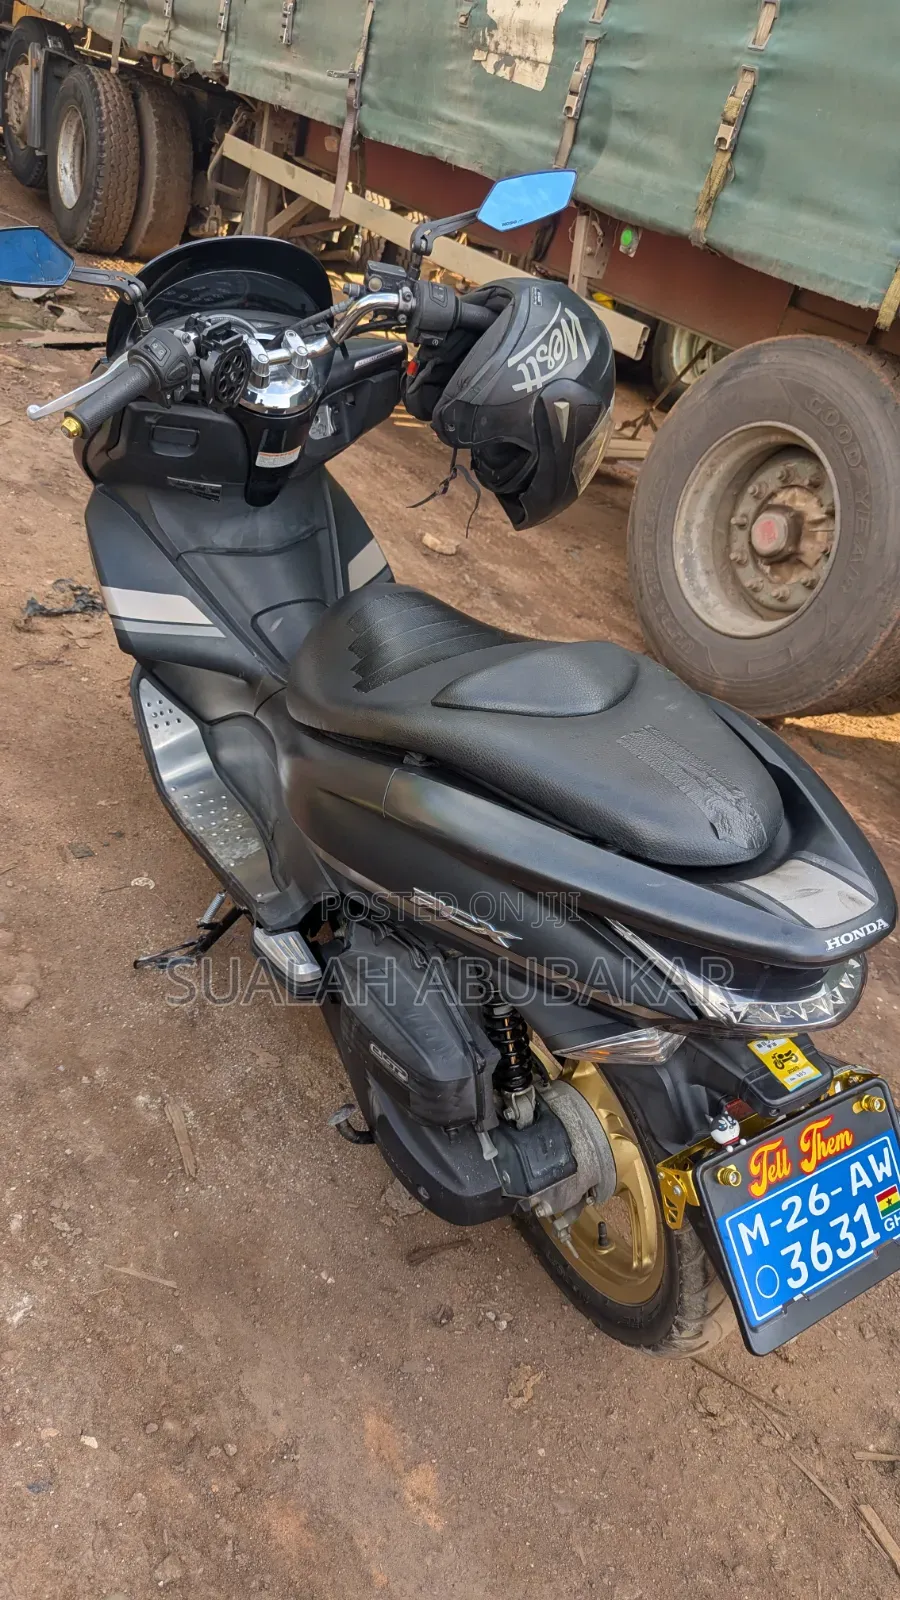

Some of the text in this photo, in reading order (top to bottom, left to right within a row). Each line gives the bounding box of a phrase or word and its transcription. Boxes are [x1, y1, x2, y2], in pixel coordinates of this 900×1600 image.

[824, 918, 890, 952] HONDA
[749, 1114, 855, 1200] Tell Them
[780, 1202, 881, 1289] 3631
